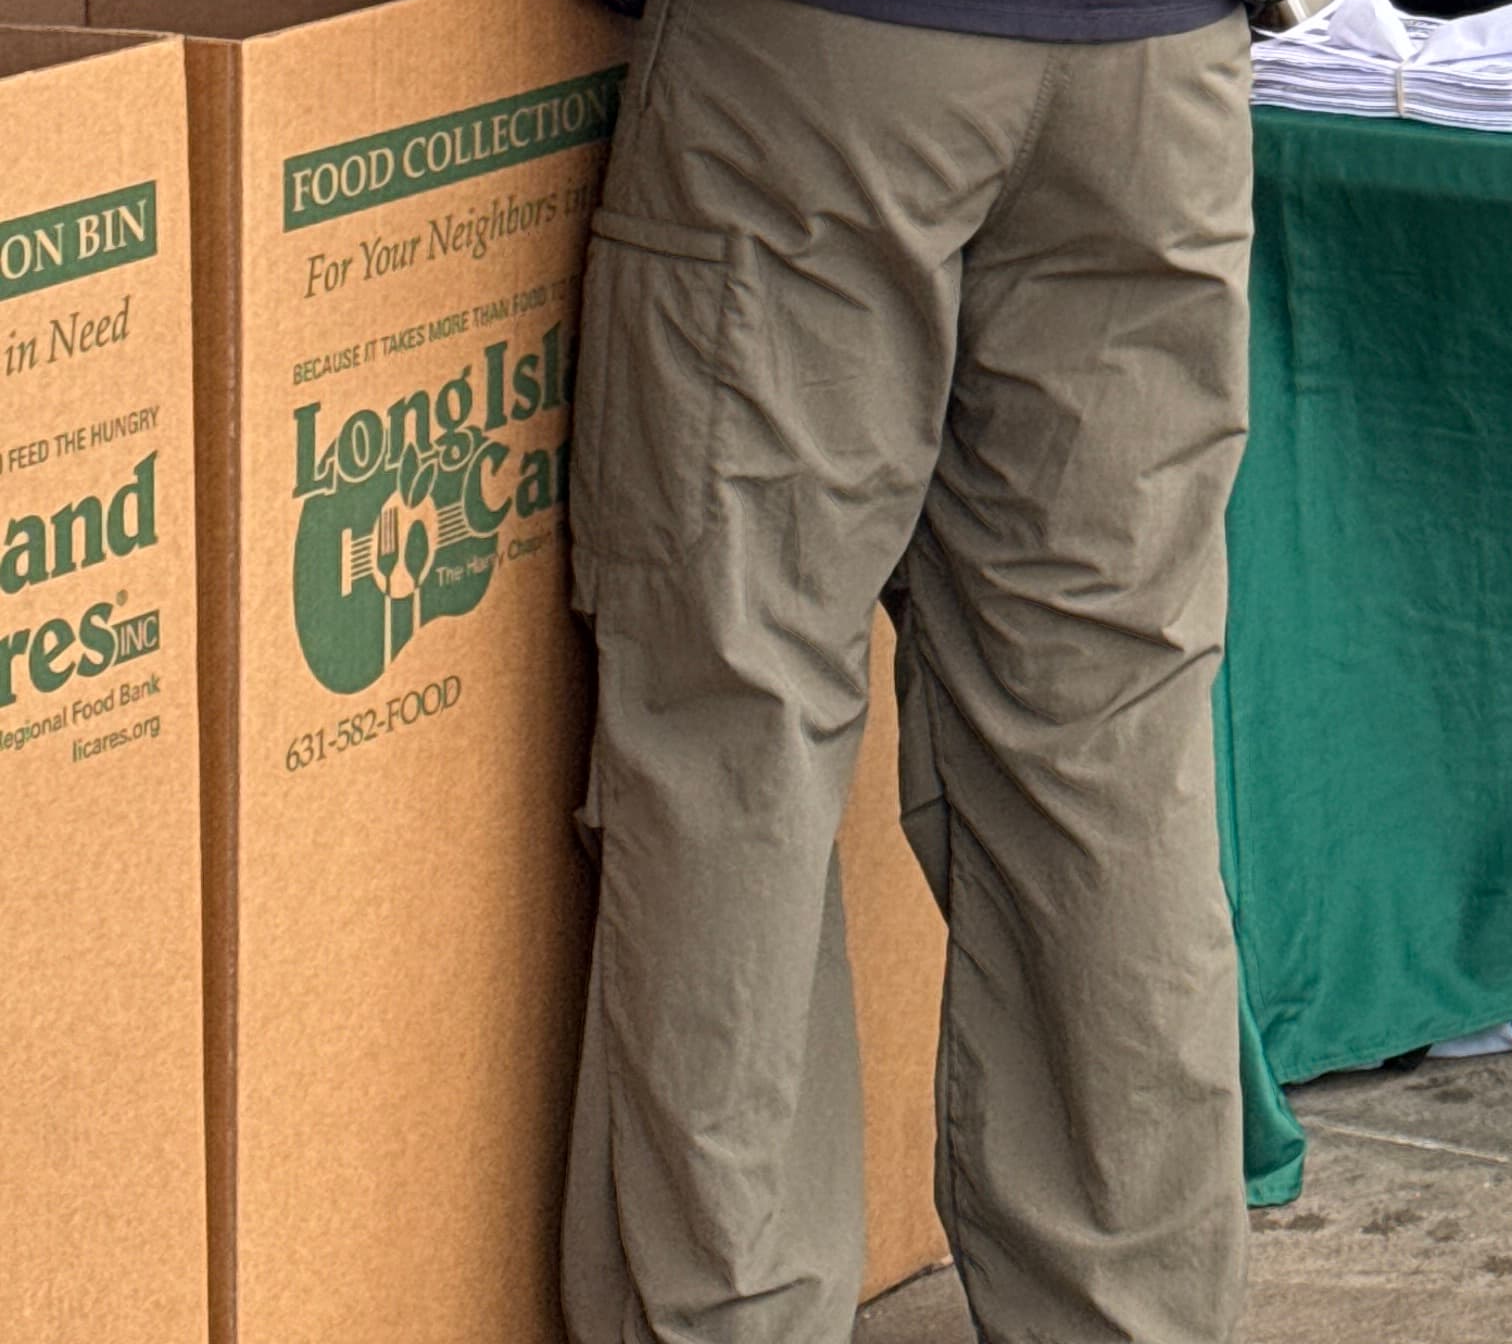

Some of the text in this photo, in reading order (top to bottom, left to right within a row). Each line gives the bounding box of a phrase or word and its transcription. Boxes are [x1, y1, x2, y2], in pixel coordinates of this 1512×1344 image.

[292, 84, 608, 212] FOOD COLLECTION
[0, 199, 148, 280] ON BIN
[303, 253, 353, 299] For
[359, 233, 421, 281] Your
[426, 192, 557, 260] Neighbors
[4, 294, 132, 376] in Need
[292, 345, 360, 386] BECAUSE
[363, 339, 381, 363] IT
[382, 323, 427, 354] TAKES
[428, 309, 469, 343] MORE
[471, 300, 509, 330] THAN
[511, 285, 547, 315] FOOD
[8, 404, 160, 473] FEED THE HUNGRY
[292, 320, 572, 500] Long Isl
[0, 449, 159, 594] and
[436, 565, 465, 588] The
[119, 615, 158, 657] INC
[72, 692, 115, 723] Food
[120, 672, 161, 706] Bank
[72, 714, 161, 763] licares.org
[285, 674, 462, 773] 631-582-FOOD
